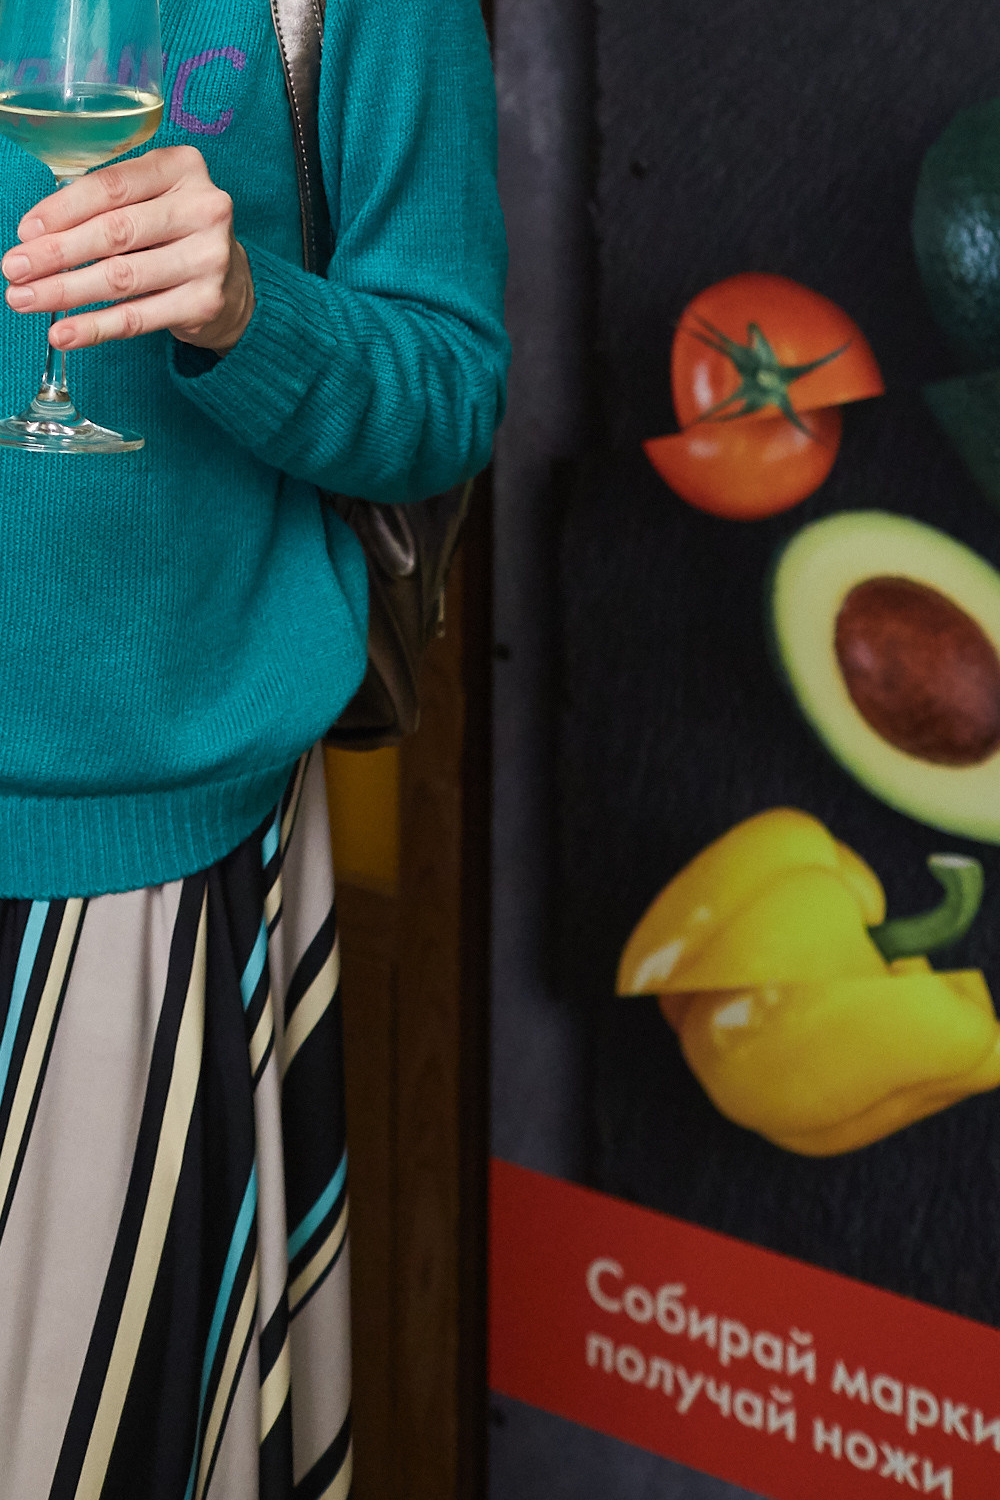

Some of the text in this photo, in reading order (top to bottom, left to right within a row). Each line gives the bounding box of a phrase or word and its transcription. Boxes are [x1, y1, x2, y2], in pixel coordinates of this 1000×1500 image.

[585, 1257, 1000, 1454] Собирай марки
[585, 1331, 954, 1500] получай ножи
